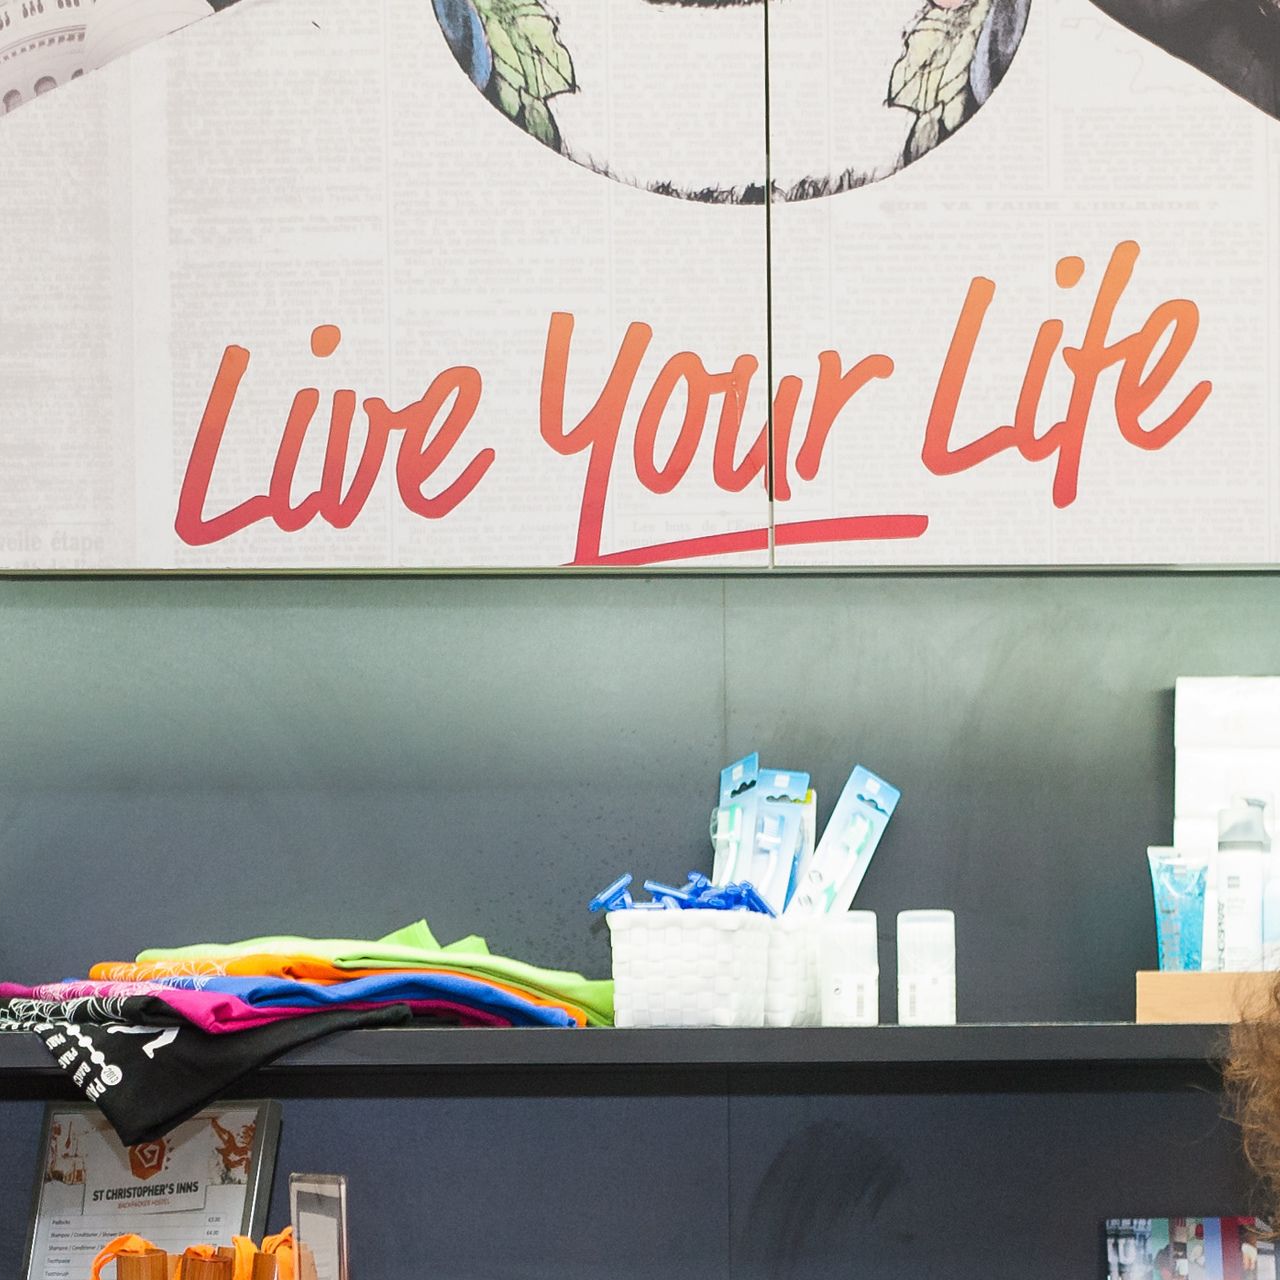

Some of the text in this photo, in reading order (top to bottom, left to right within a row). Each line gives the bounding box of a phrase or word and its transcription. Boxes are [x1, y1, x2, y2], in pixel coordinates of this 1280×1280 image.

[175, 325, 495, 546] Live
[540, 311, 895, 565] Your
[922, 240, 1213, 508] Life
[92, 1181, 199, 1202] ST CHRISTOPHER'S INNS
